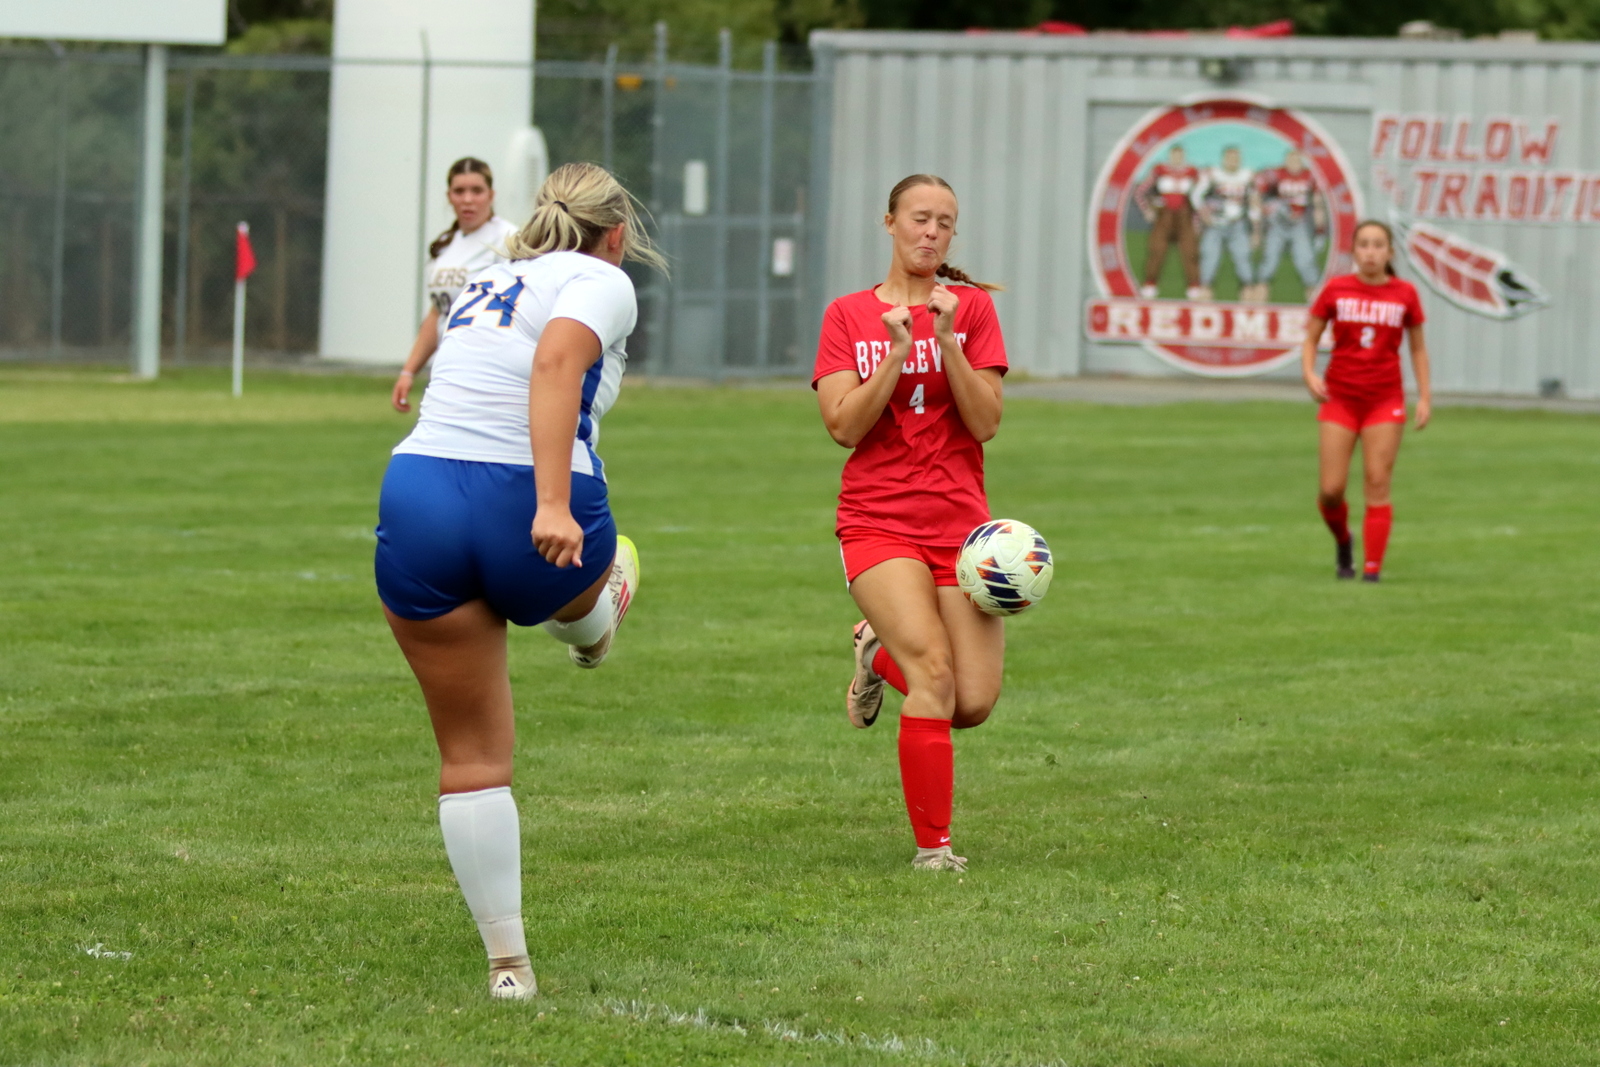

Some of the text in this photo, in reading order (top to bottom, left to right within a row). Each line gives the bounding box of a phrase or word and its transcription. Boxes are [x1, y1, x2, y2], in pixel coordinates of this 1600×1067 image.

[1371, 116, 1559, 163] FOLLOW
[428, 267, 467, 288] ERS
[446, 273, 528, 332] 24
[1108, 305, 1335, 346] REDME
[1360, 326, 1375, 348] 2
[855, 332, 967, 379] BEEV
[909, 384, 925, 414] 4
